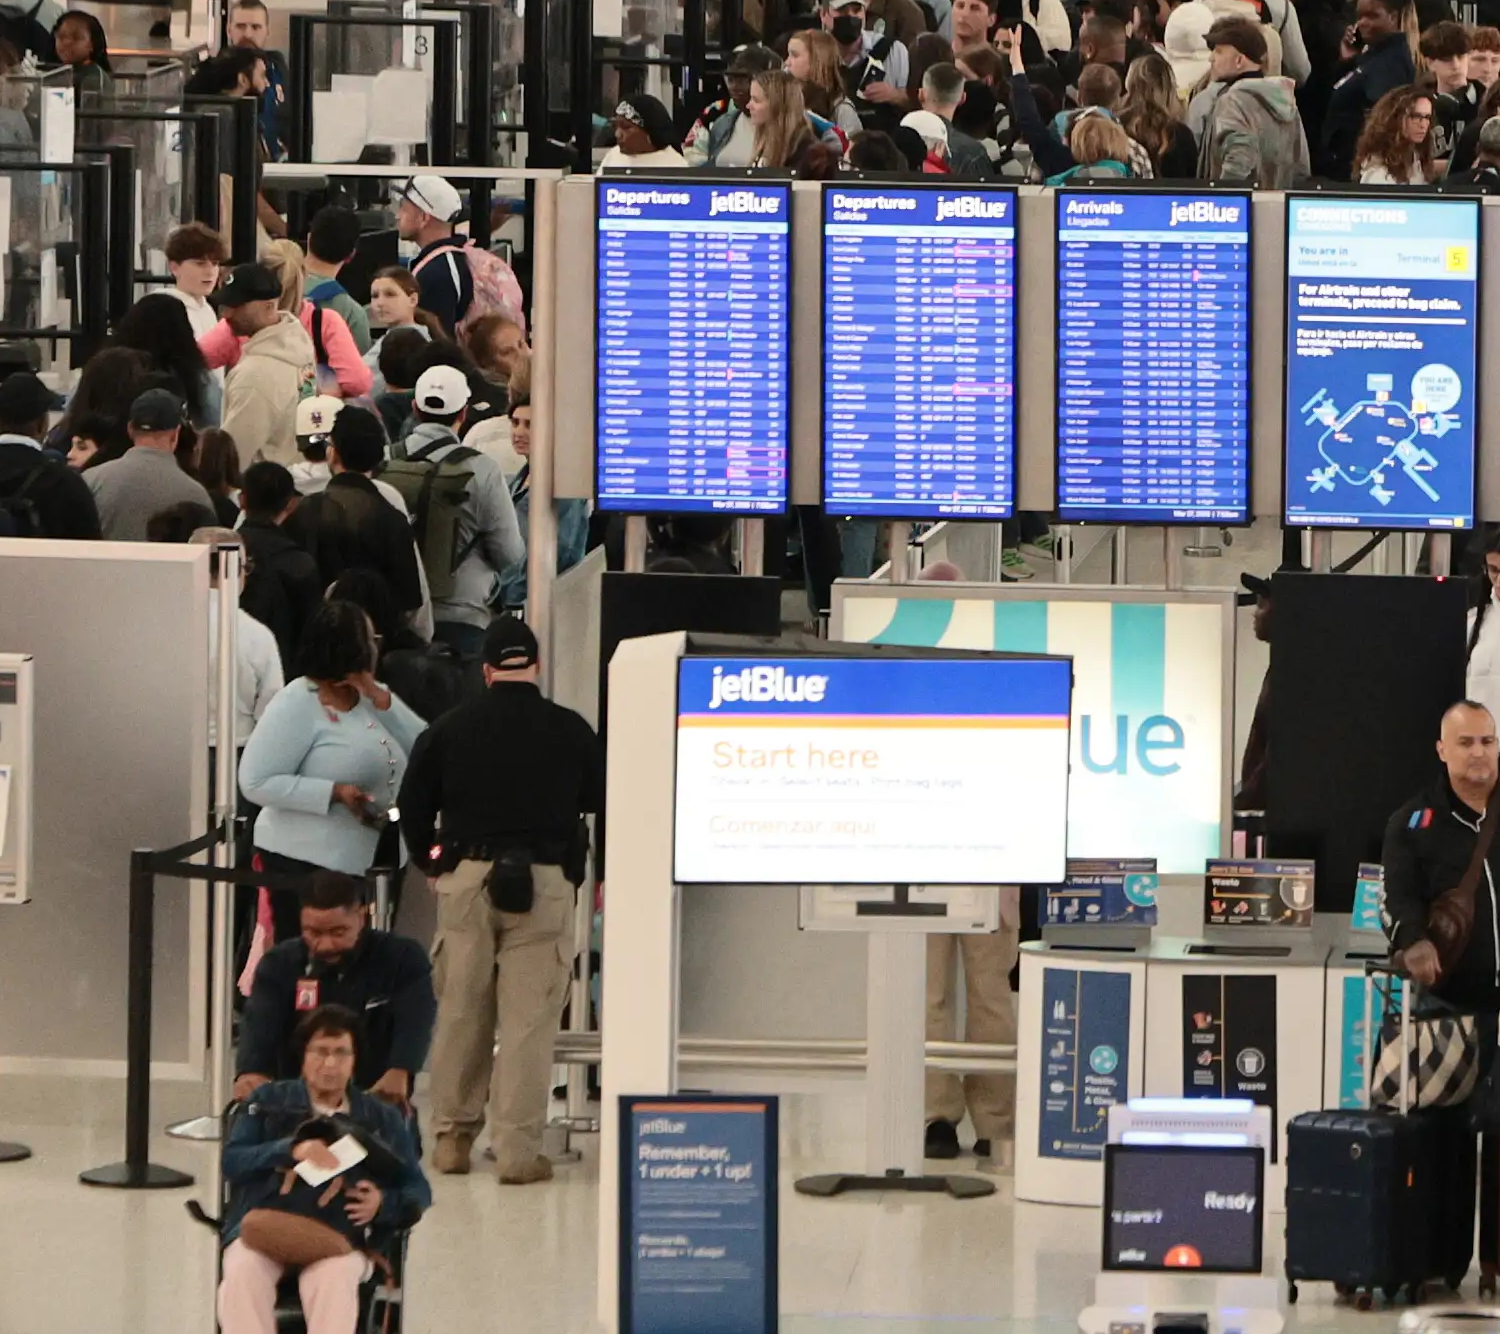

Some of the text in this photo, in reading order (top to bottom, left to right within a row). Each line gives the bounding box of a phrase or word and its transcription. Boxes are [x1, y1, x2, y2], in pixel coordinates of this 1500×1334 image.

[606, 188, 780, 217] Departures jetBlue
[832, 194, 1008, 222] Departures jetBlue
[1066, 199, 1240, 227] Arrivals jetBlue
[1397, 252, 1441, 265] Terminal
[1452, 252, 1462, 267] 5
[708, 664, 829, 710] jetBlue
[711, 740, 880, 770] Start here
[708, 815, 824, 837] Comenzar
[638, 1143, 731, 1163] Remember,
[649, 1163, 696, 1180] under
[725, 1163, 752, 1183] up!
[1204, 1189, 1257, 1215] Ready
